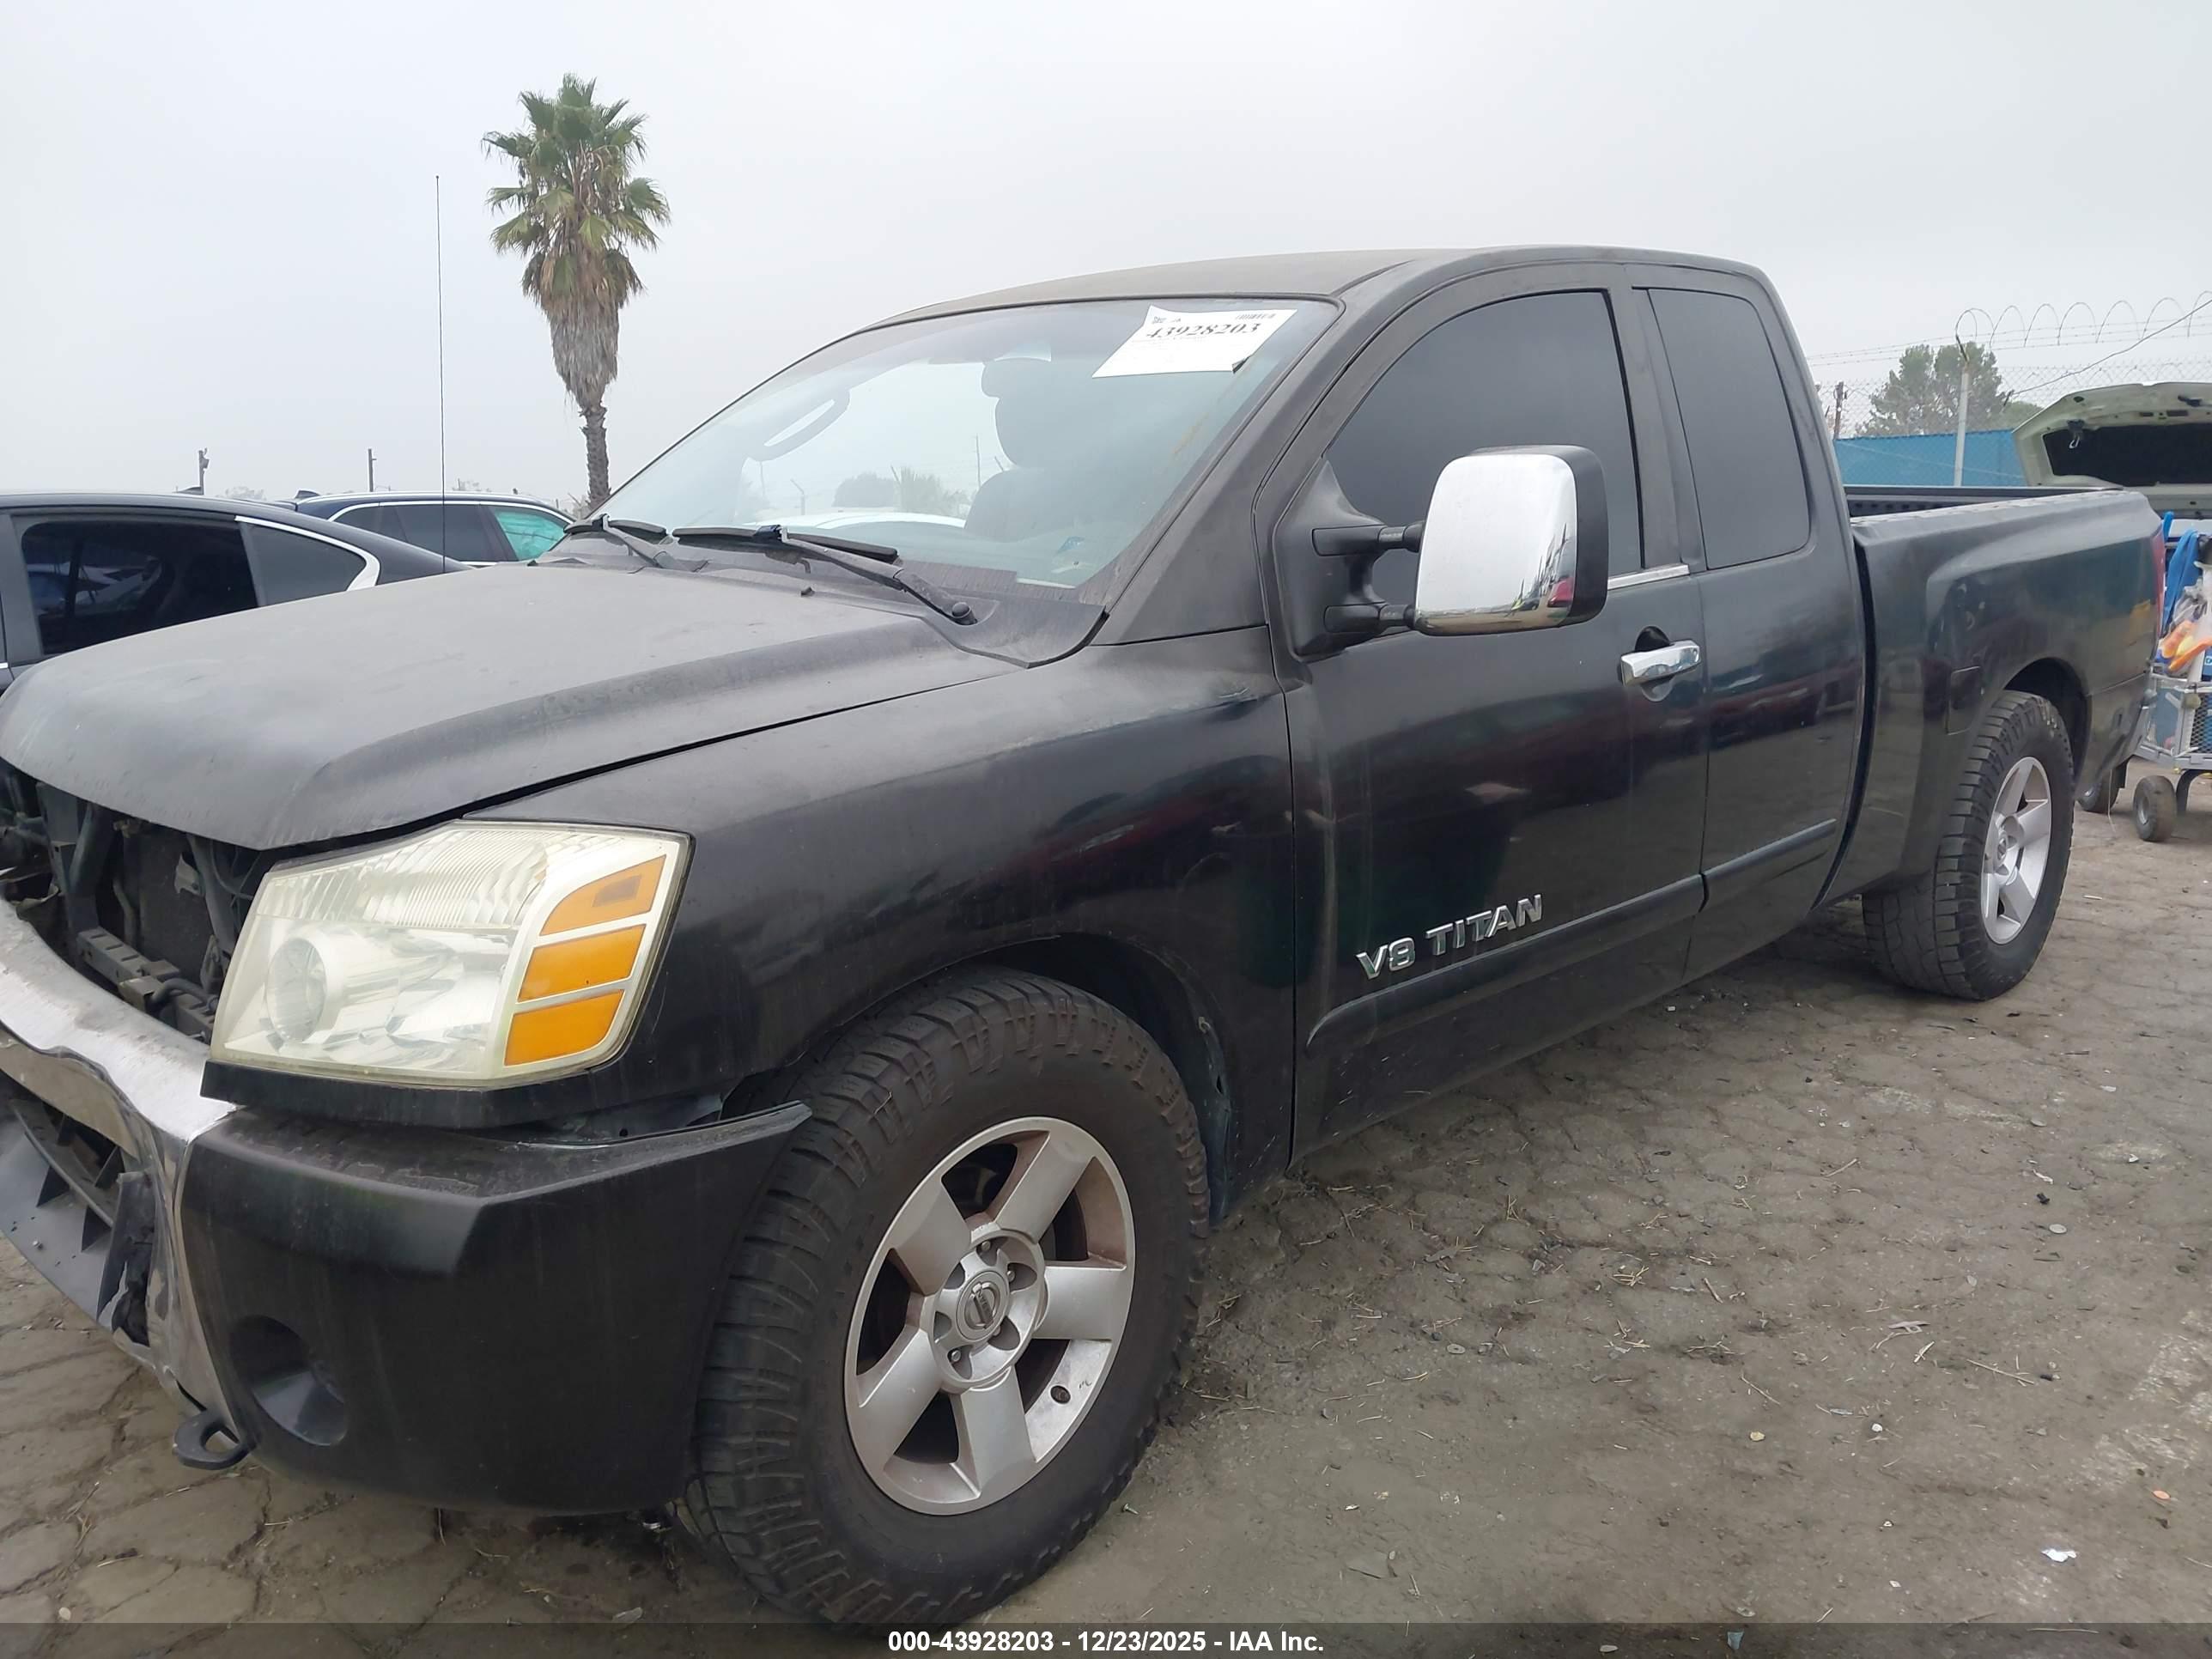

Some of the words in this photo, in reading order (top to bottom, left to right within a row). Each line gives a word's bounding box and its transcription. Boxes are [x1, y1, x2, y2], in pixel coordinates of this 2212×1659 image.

[1146, 323, 1261, 337] 43928203
[1356, 937, 1416, 980] V8
[1425, 894, 1542, 956] TITAN
